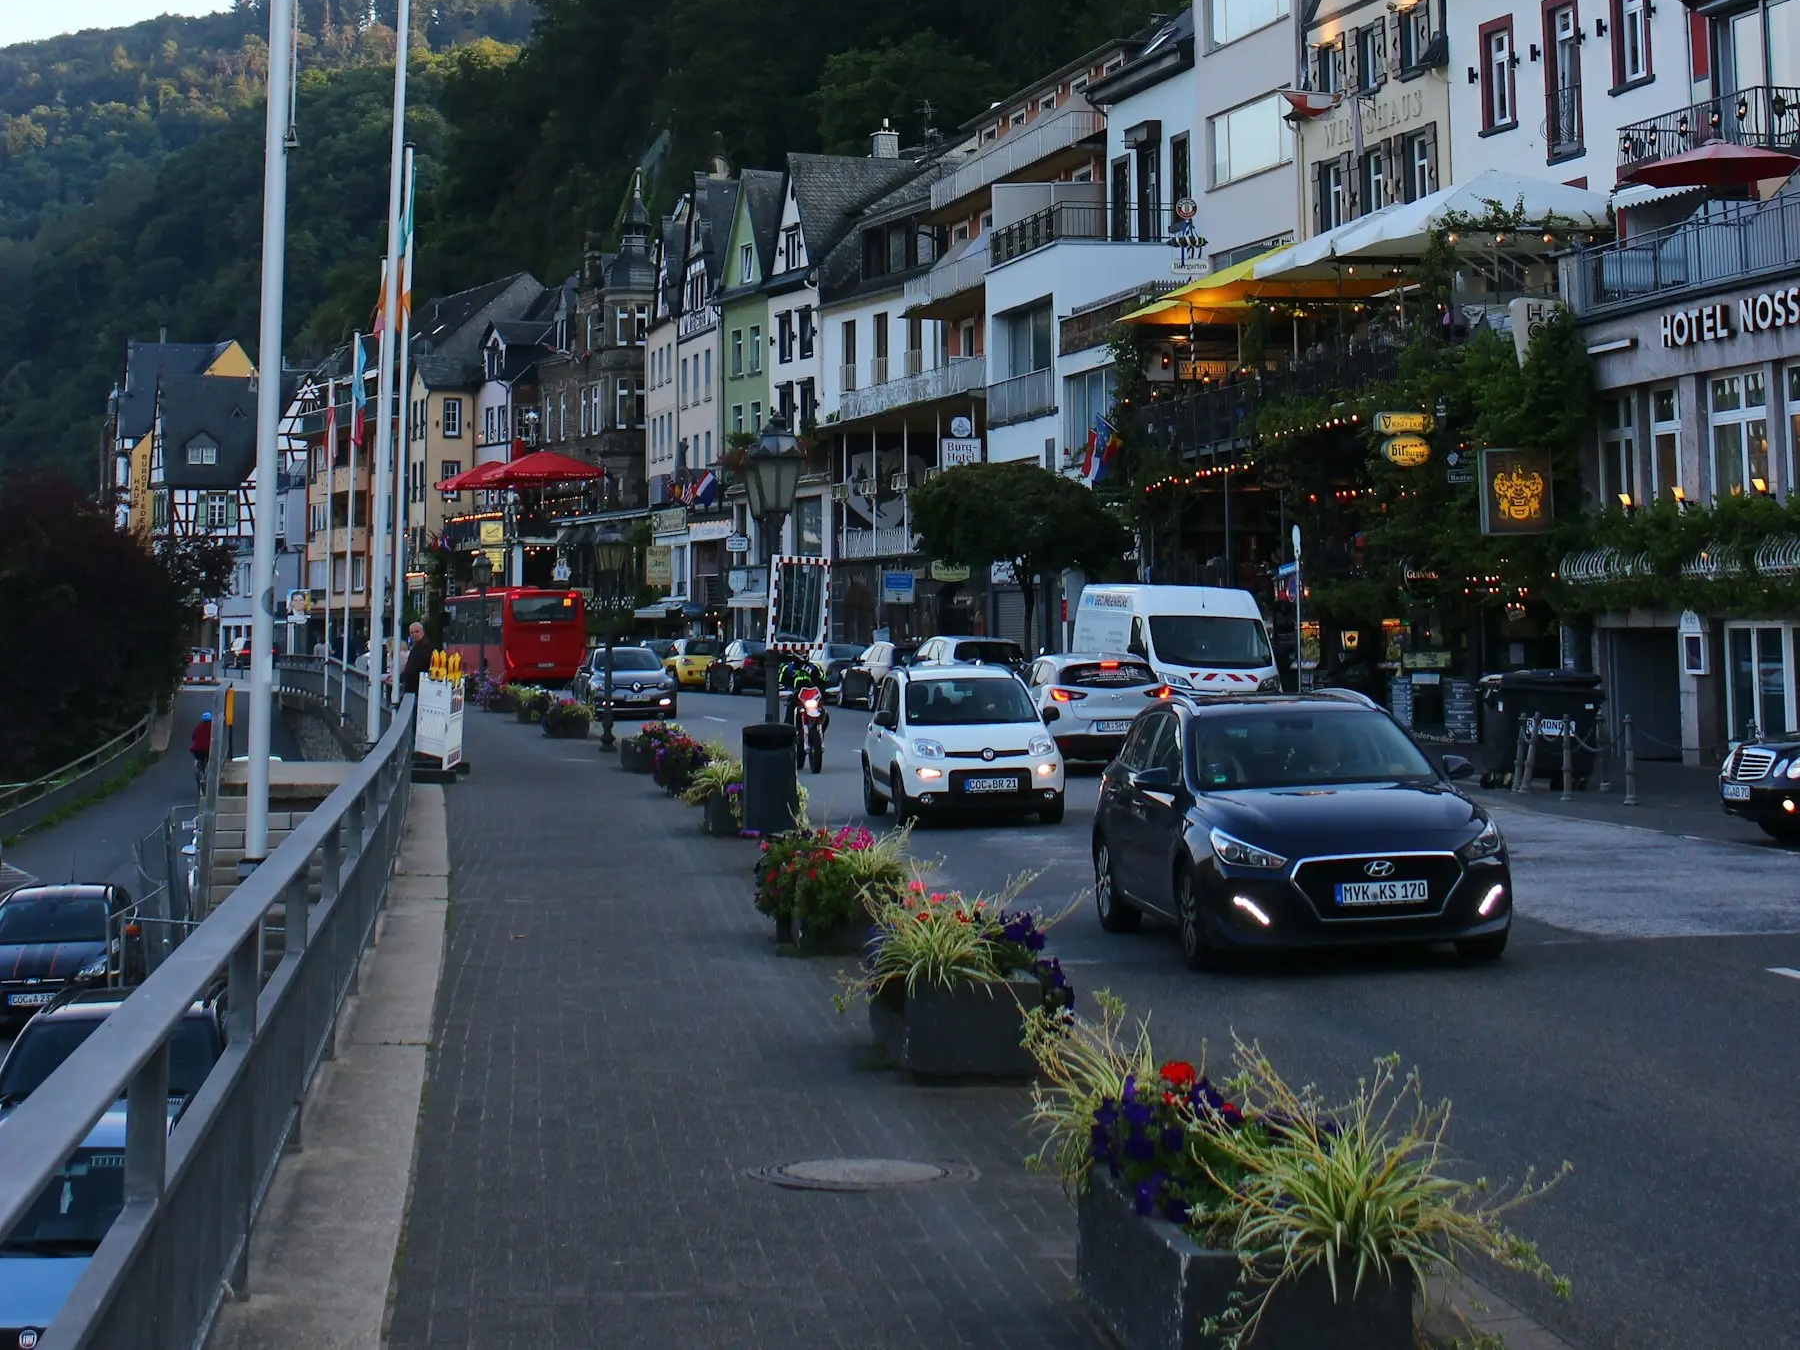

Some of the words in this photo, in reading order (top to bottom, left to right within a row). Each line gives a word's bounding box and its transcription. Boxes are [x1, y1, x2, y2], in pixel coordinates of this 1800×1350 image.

[1660, 304, 1728, 347] HOTEL
[1739, 287, 1800, 333] NOSS
[947, 441, 978, 454] Burg-
[947, 452, 975, 462] Hotel
[969, 780, 987, 789] COC
[992, 779, 1004, 789] BR
[1006, 779, 1017, 788] 21
[1343, 885, 1370, 901] MYK
[1380, 883, 1397, 900] KS
[1401, 882, 1426, 899] 170
[12, 995, 28, 1004] COC
[33, 995, 39, 1003] A
